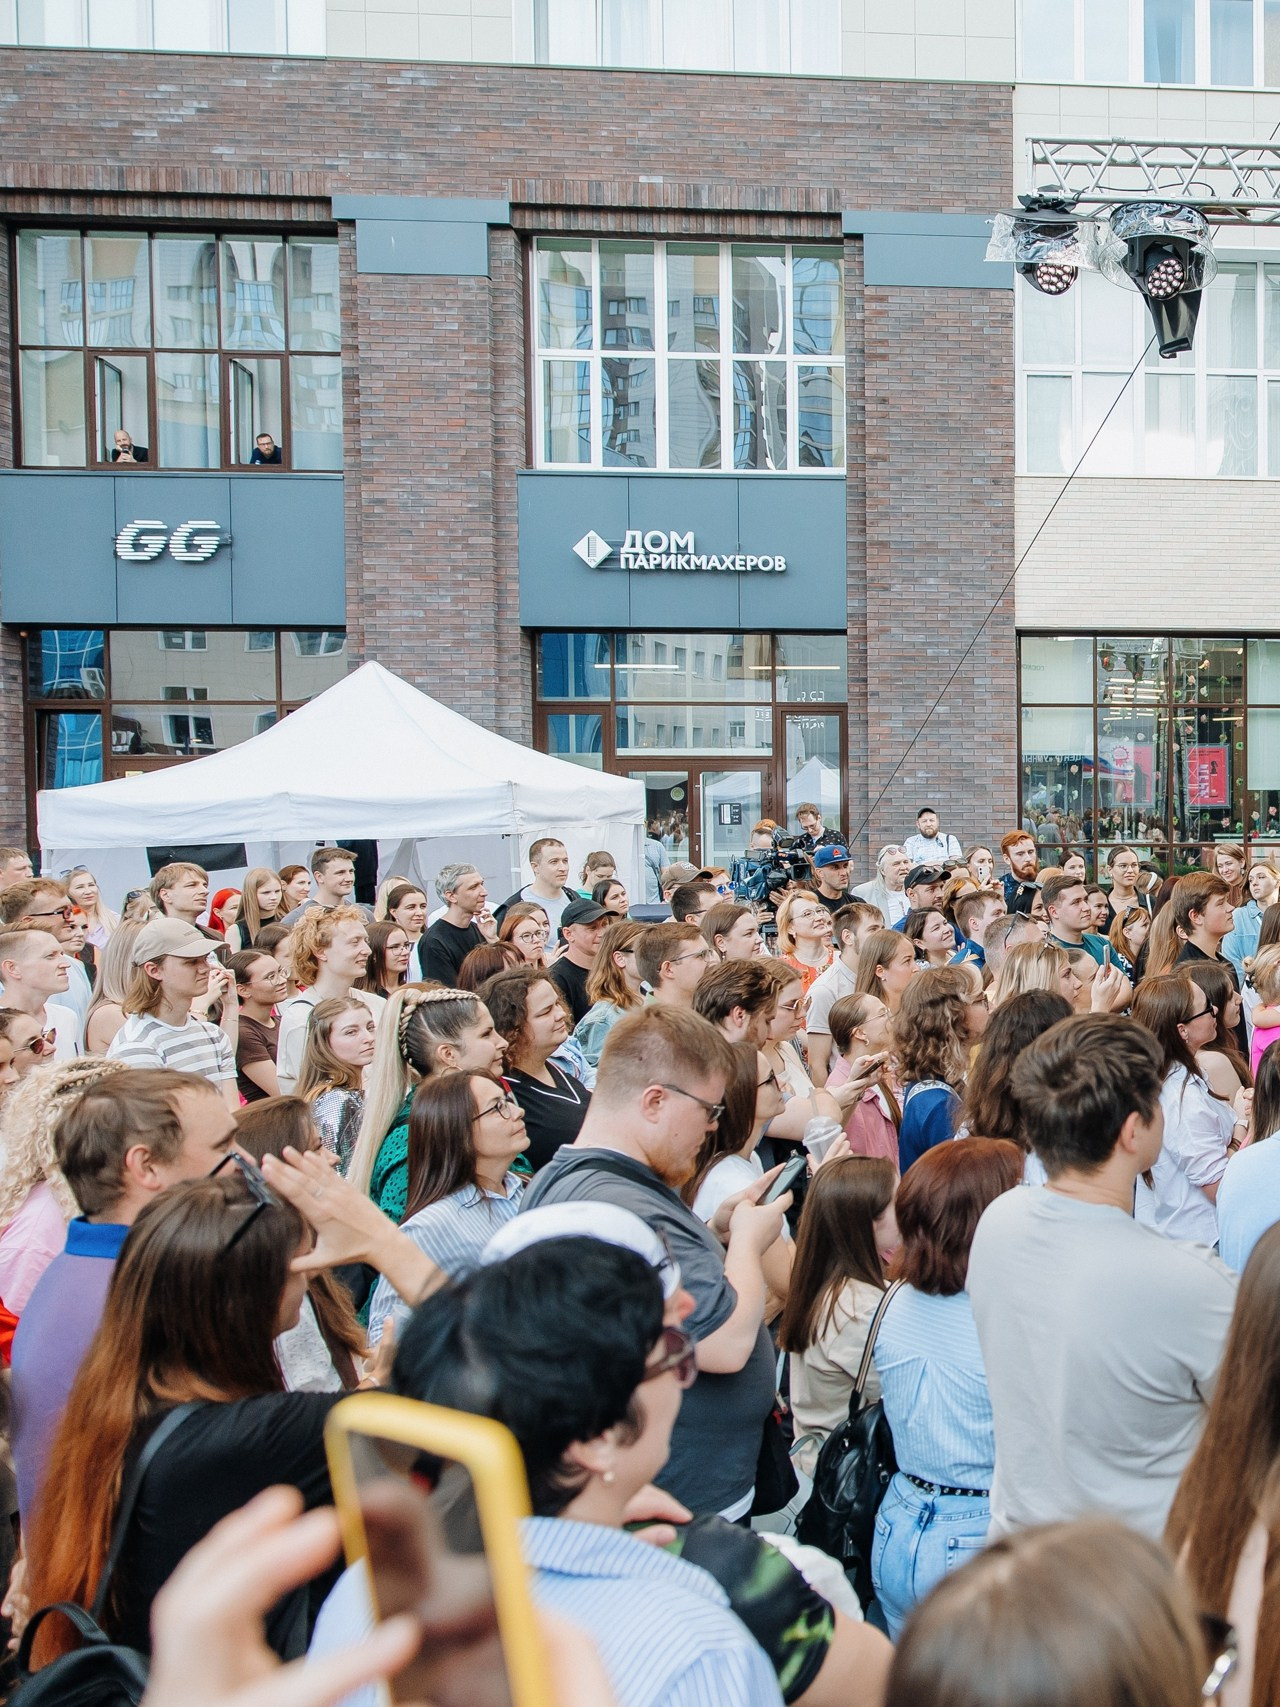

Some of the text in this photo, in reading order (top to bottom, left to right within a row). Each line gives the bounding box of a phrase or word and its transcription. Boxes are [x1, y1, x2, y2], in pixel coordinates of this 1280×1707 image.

[116, 520, 221, 561] GG
[620, 530, 695, 554] ДОМ
[620, 553, 787, 571] ПАРИКМАХЕРОВ
